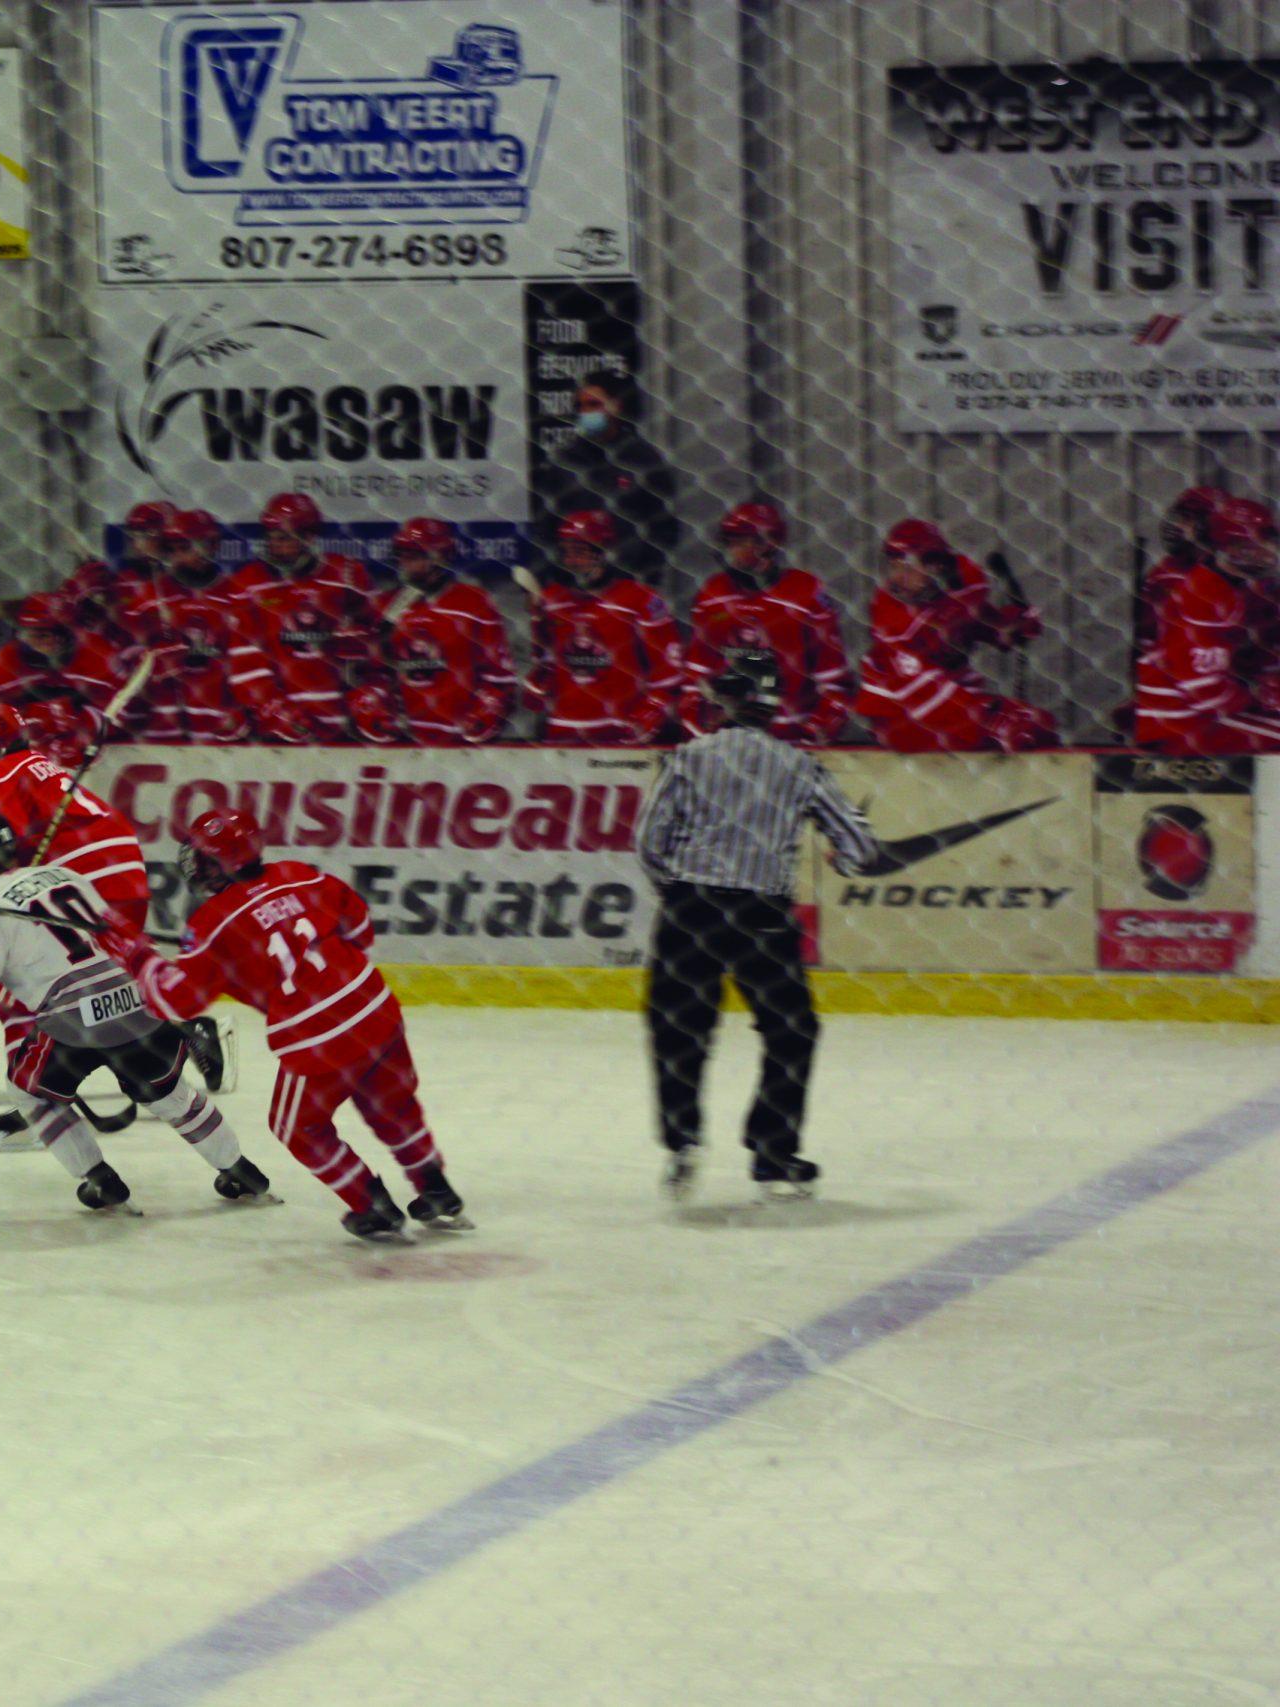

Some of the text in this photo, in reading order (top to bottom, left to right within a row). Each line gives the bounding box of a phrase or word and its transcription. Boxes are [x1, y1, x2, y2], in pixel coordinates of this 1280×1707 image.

[287, 97, 493, 133] TOM VEERT
[923, 102, 1099, 154] WEST
[268, 141, 518, 179] CONTRACTING
[293, 475, 492, 498] ENTERPRISES
[109, 764, 645, 853] Cousineau
[353, 864, 636, 939] Estate
[839, 883, 1073, 909] HOCKEY
